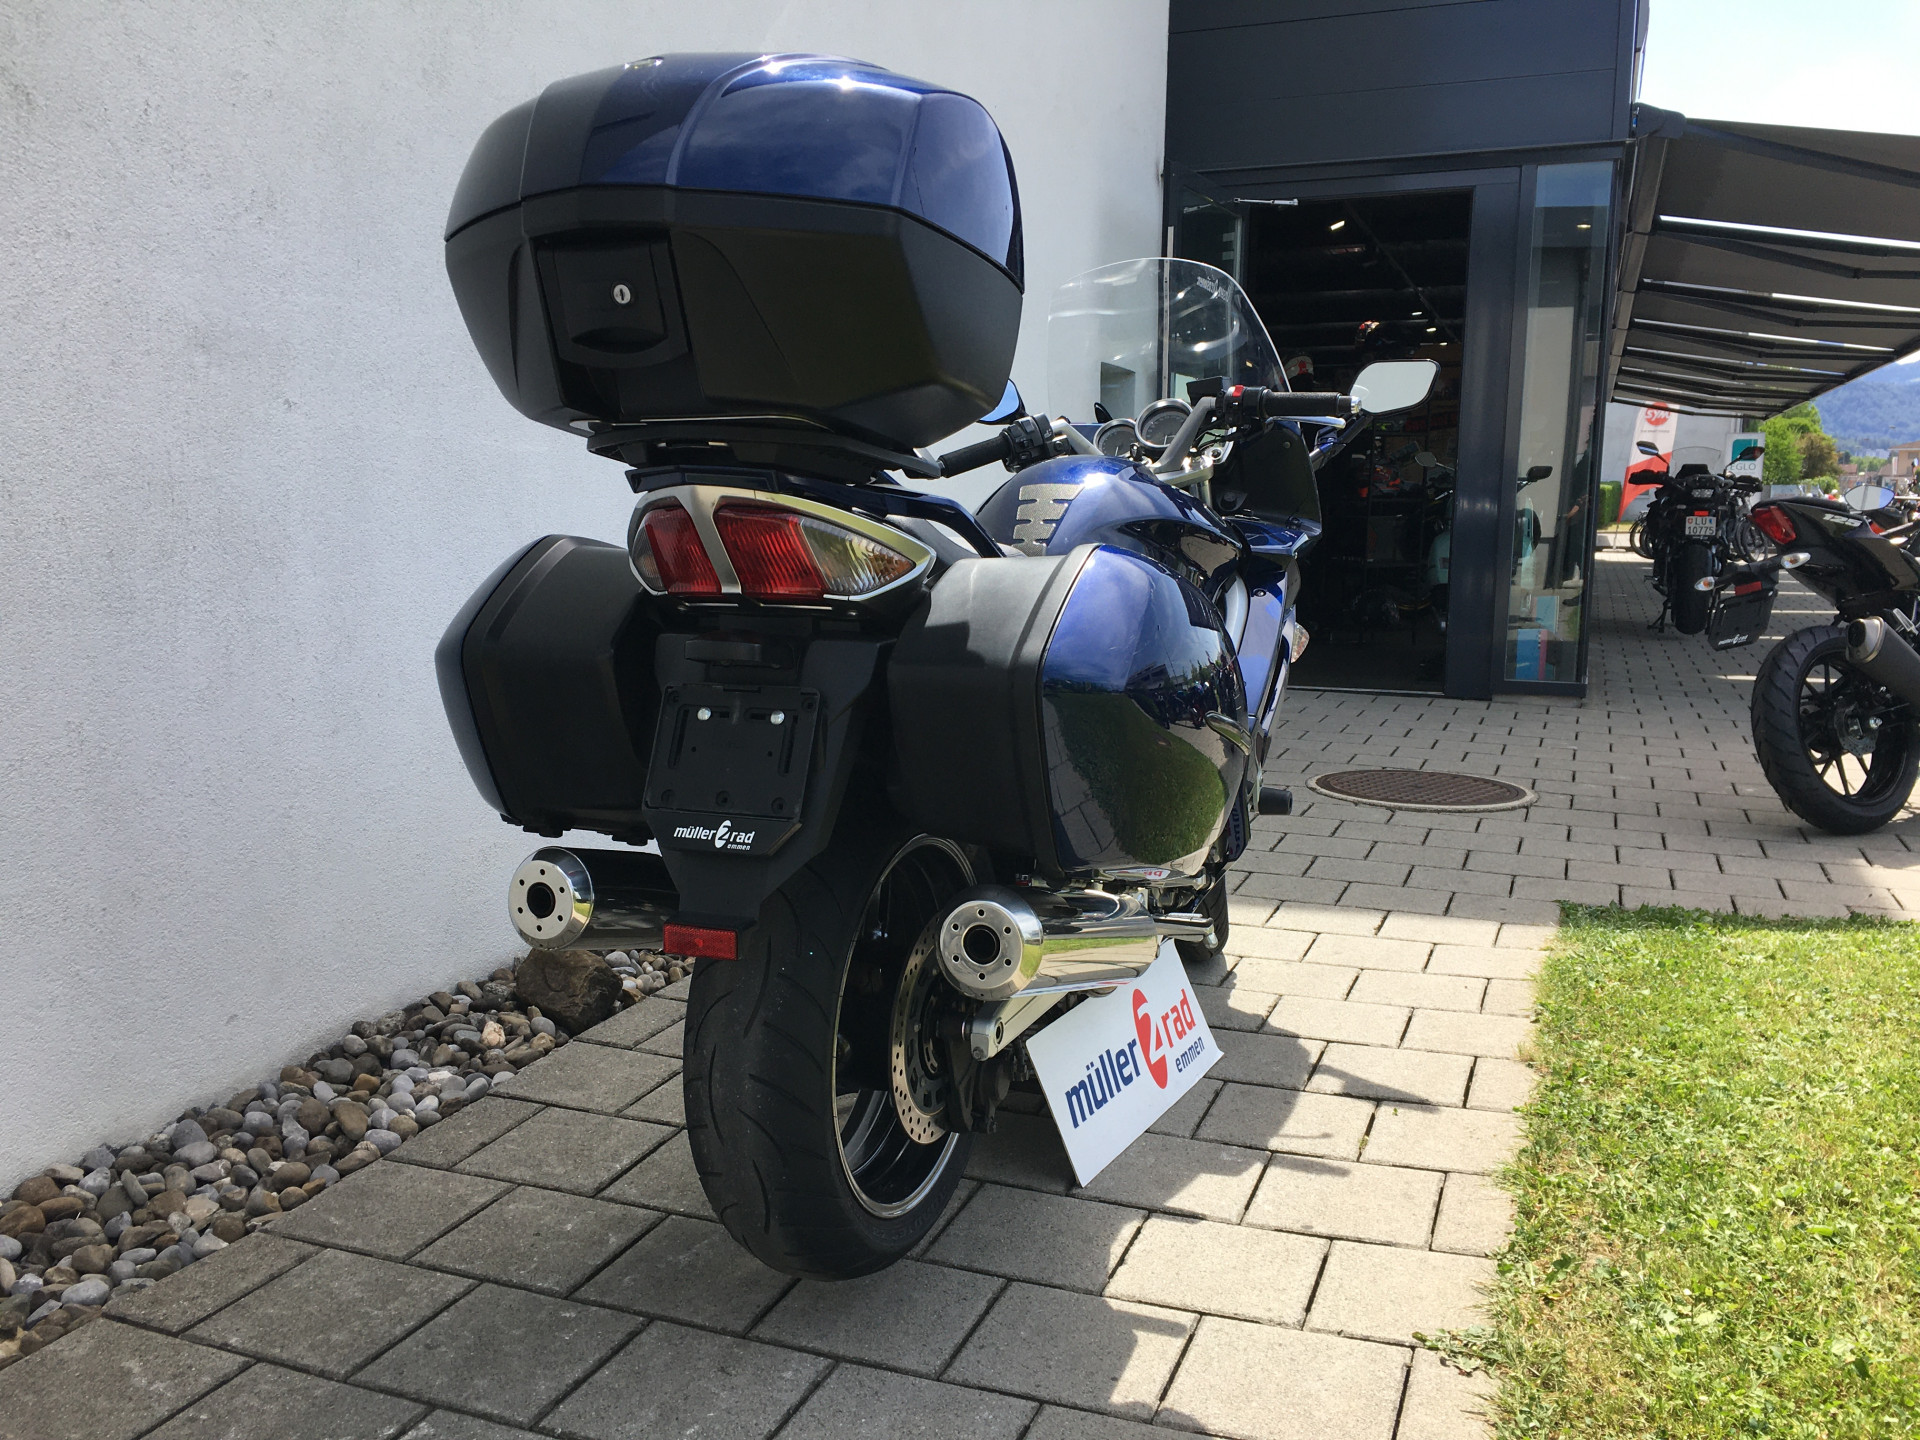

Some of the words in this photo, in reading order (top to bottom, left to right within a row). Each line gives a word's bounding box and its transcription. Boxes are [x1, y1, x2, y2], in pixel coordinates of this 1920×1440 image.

[1730, 463, 1757, 471] EGLO
[1694, 517, 1707, 526] LU
[1822, 513, 1862, 527] 125
[1687, 526, 1714, 535] 10775
[727, 843, 751, 851] emmen
[1175, 1036, 1206, 1073] emmen
